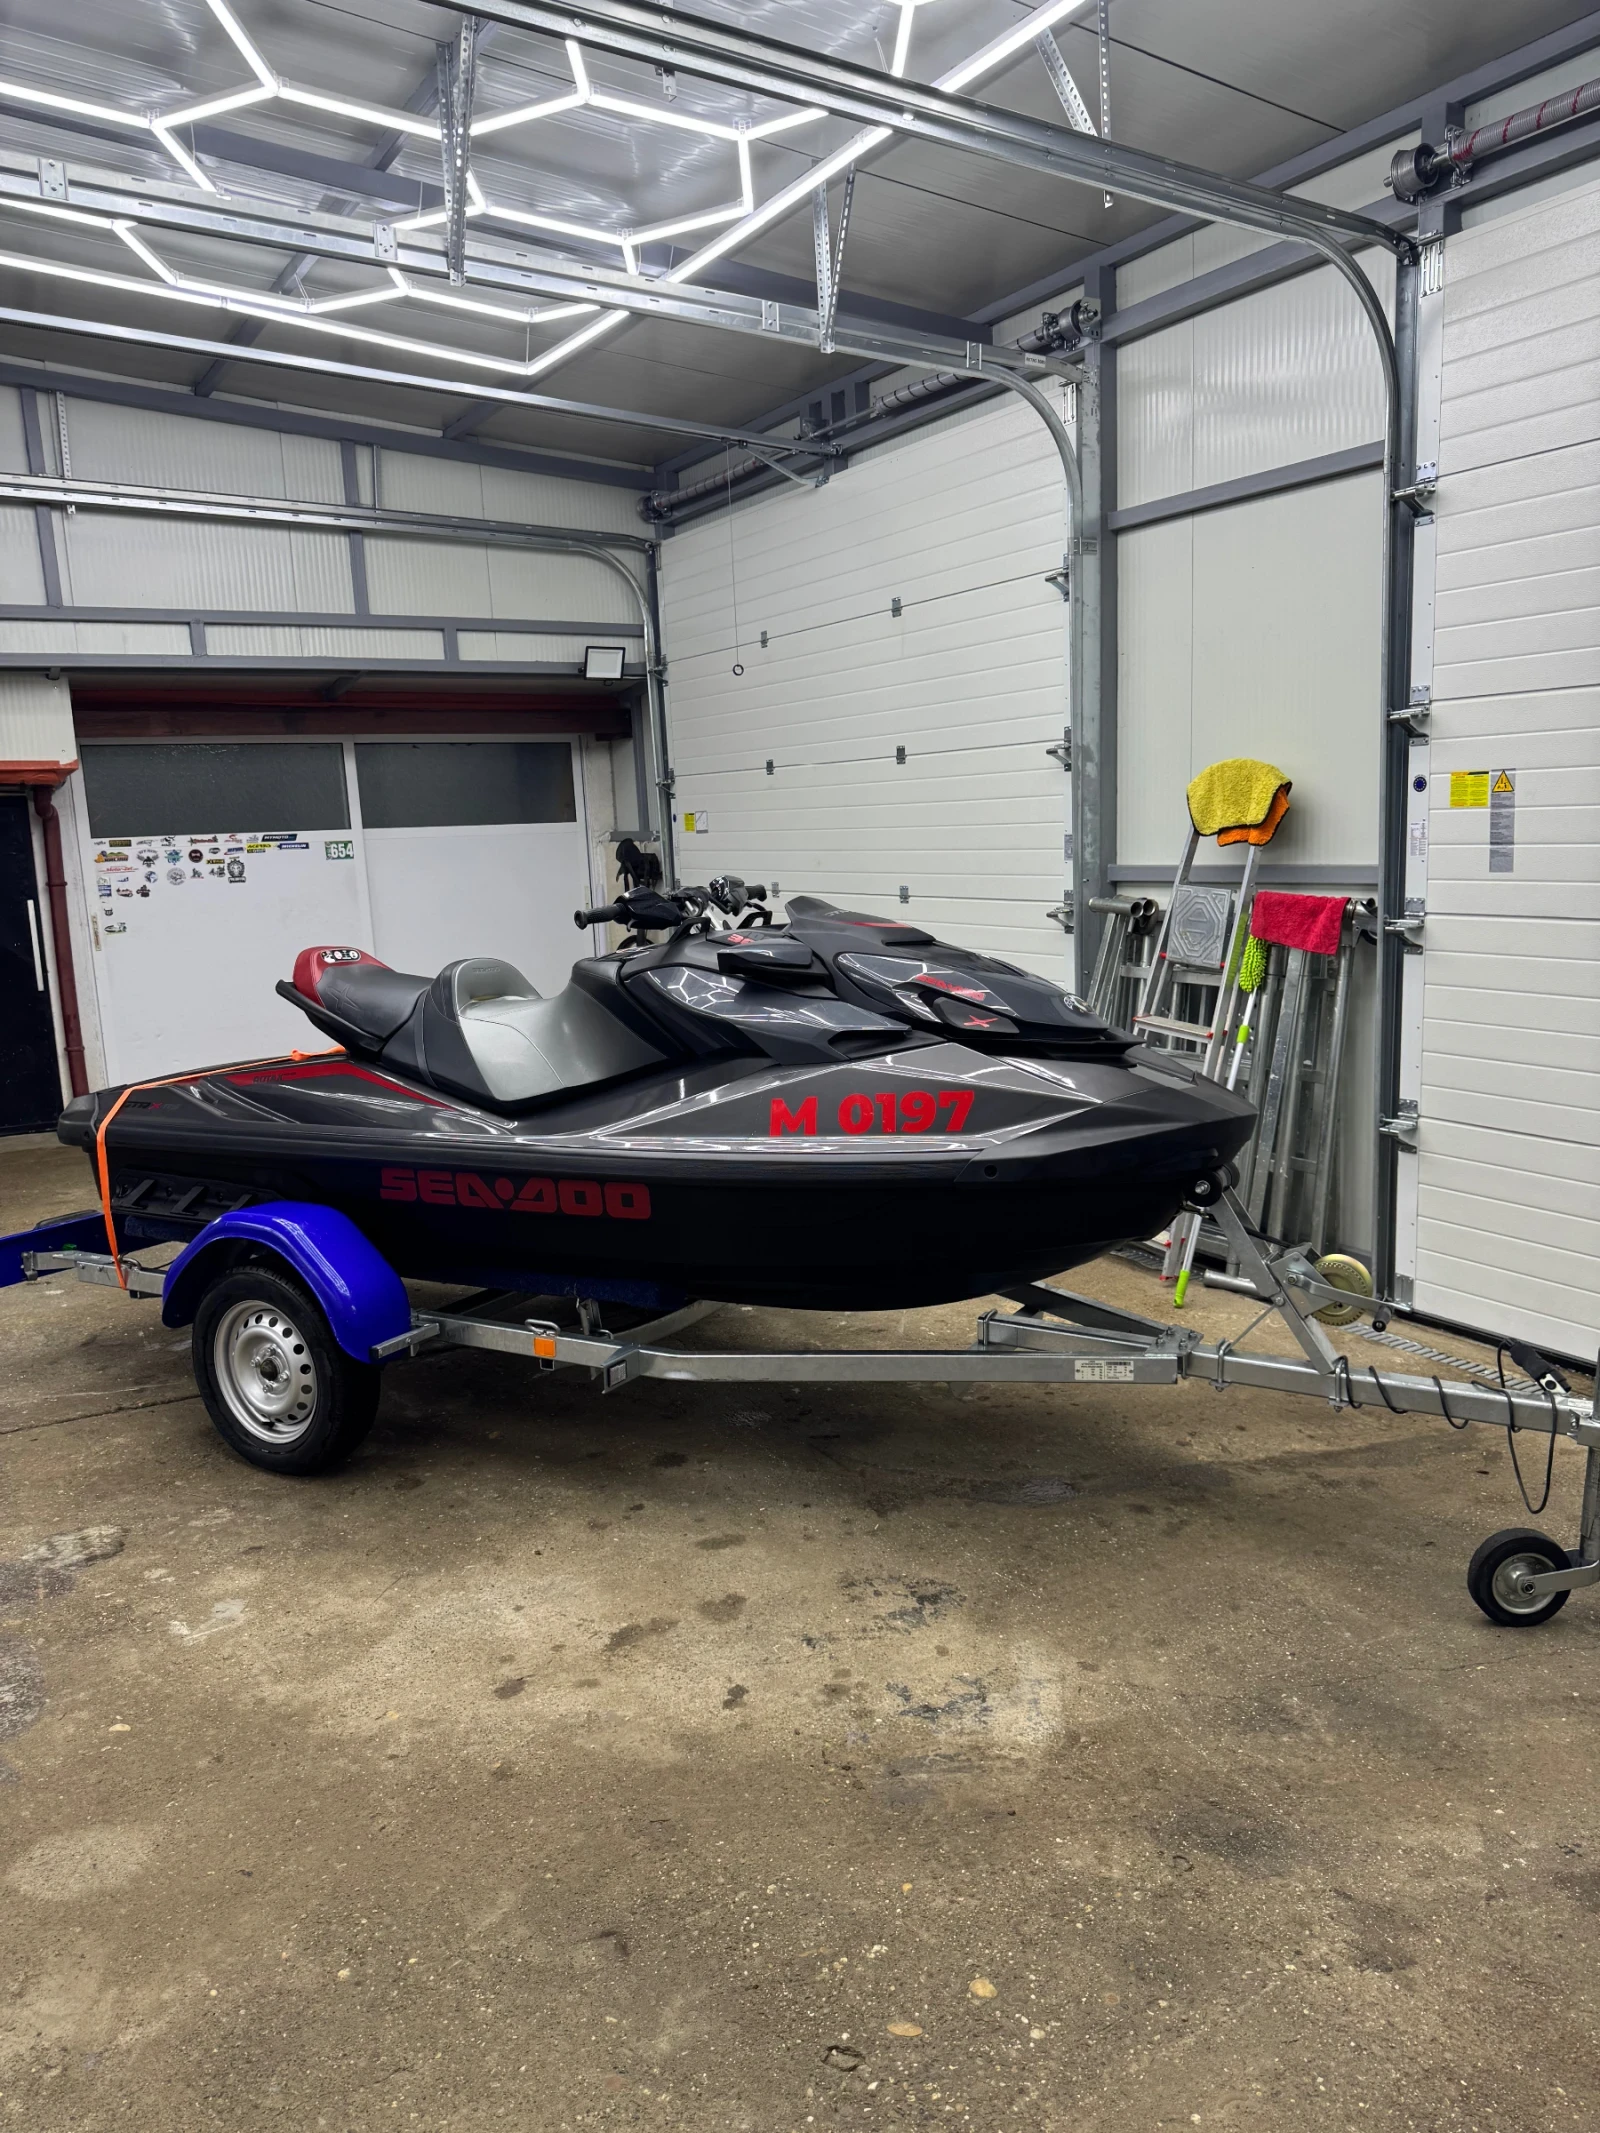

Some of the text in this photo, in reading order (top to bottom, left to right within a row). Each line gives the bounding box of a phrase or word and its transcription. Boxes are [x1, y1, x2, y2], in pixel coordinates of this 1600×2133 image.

[330, 842, 354, 858] 654
[768, 1089, 976, 1139] M 0197
